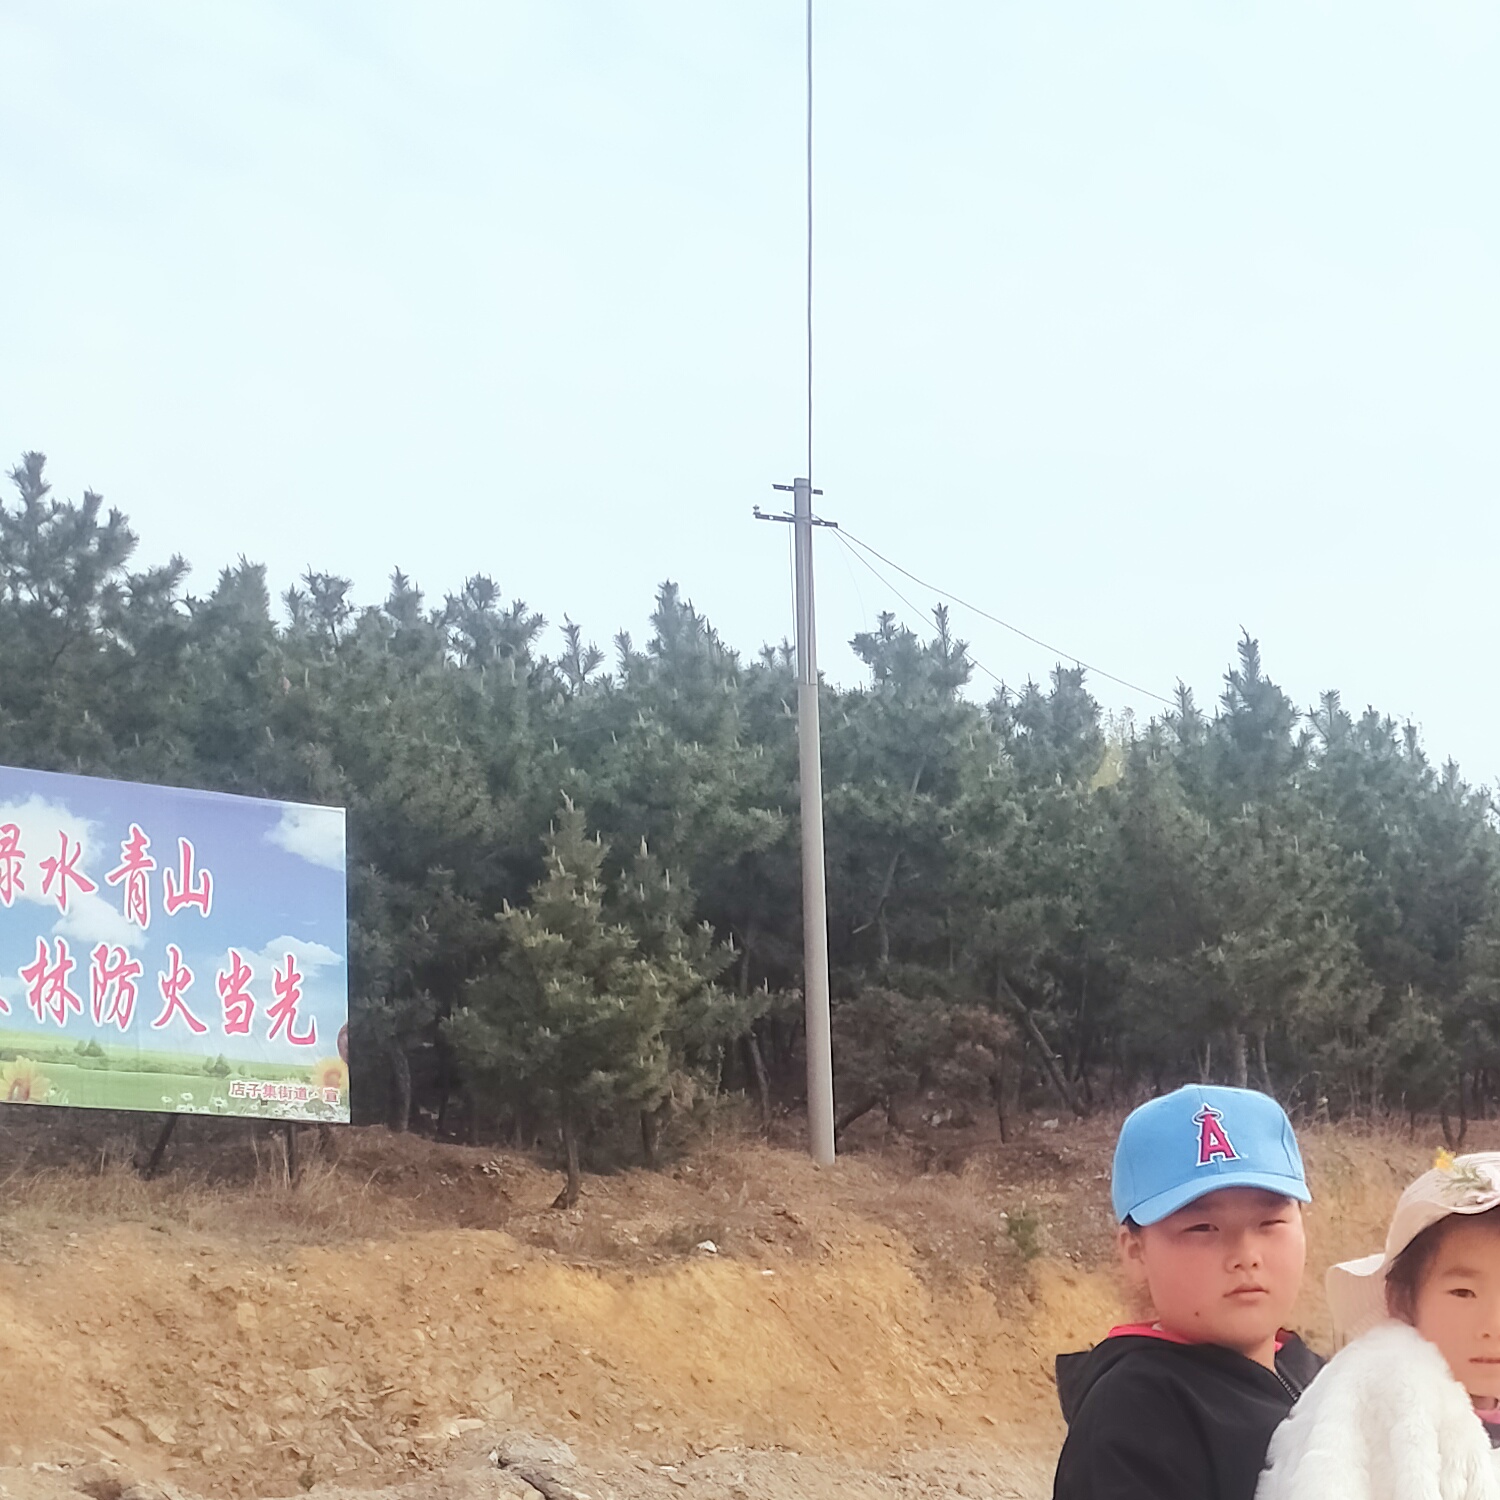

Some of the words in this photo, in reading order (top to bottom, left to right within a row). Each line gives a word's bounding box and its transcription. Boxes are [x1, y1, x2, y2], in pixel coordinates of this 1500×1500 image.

[0, 937, 316, 1045] 林防火当先
[1193, 1104, 1240, 1166] A
